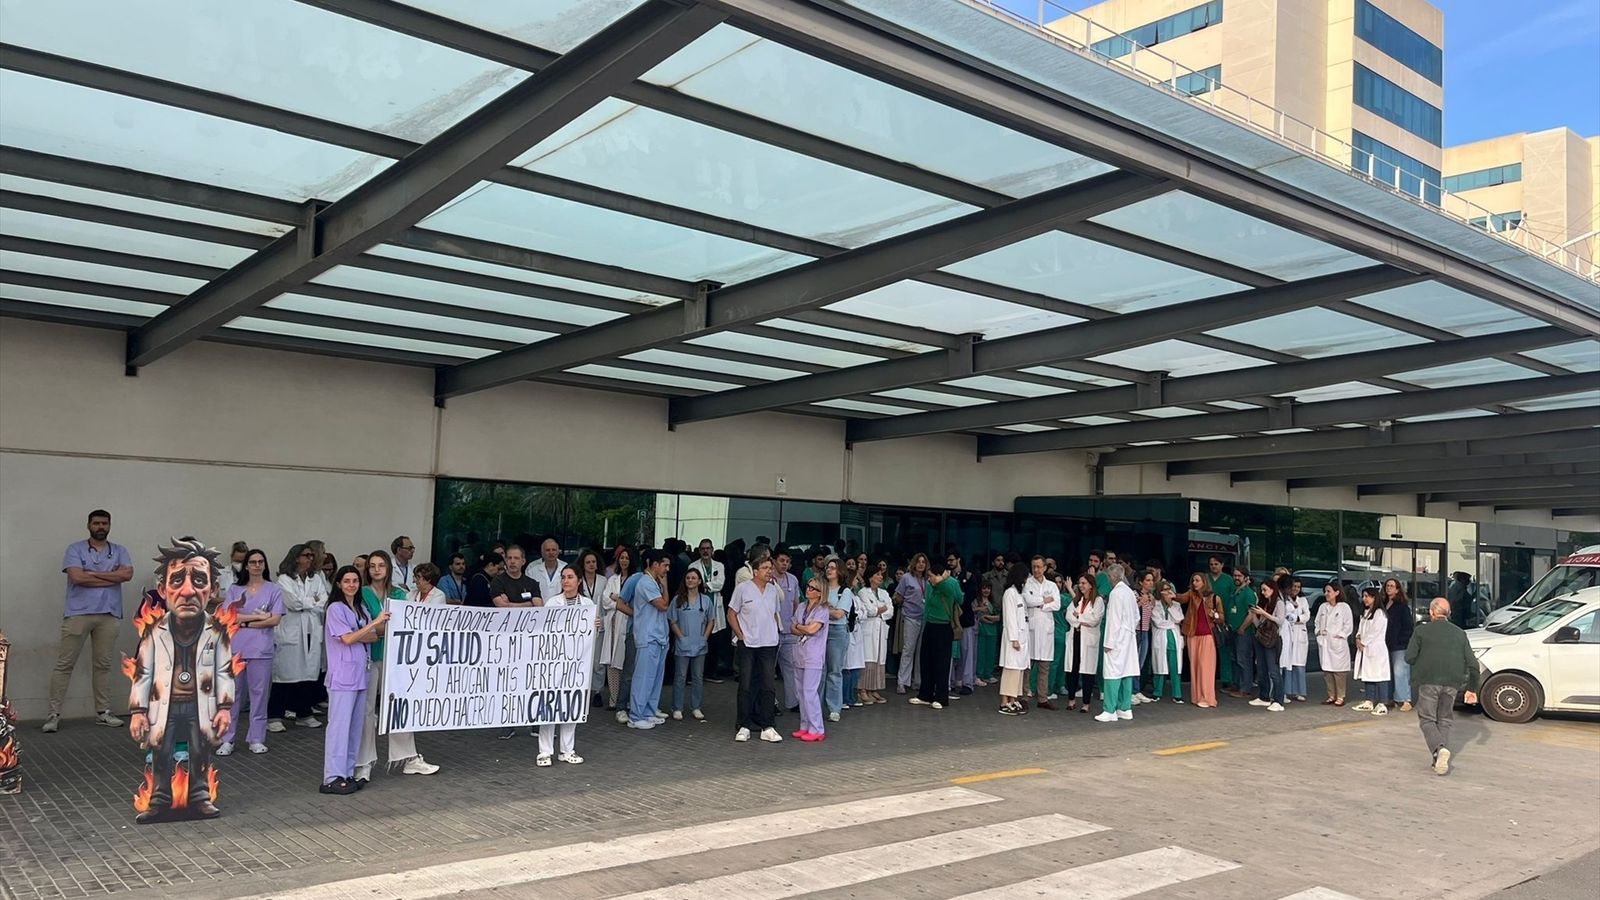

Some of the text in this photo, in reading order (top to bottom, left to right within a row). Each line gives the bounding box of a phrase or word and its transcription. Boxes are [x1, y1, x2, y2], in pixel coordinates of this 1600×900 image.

[404, 605, 592, 636] REMITIÉNDOME A LOS HECHOS,
[393, 631, 423, 665] TU
[426, 632, 484, 667] SALUD,
[487, 634, 503, 664] ES
[528, 634, 584, 661] TRABAJO
[406, 668, 419, 692] Y
[426, 666, 439, 693] SI
[446, 666, 490, 694] AHOGAN
[525, 661, 585, 690] DERECHOS
[386, 693, 409, 734] ¡NO
[412, 697, 451, 727] PUEDO
[453, 695, 496, 726] HACERLO
[527, 689, 589, 723] CARAJO!
